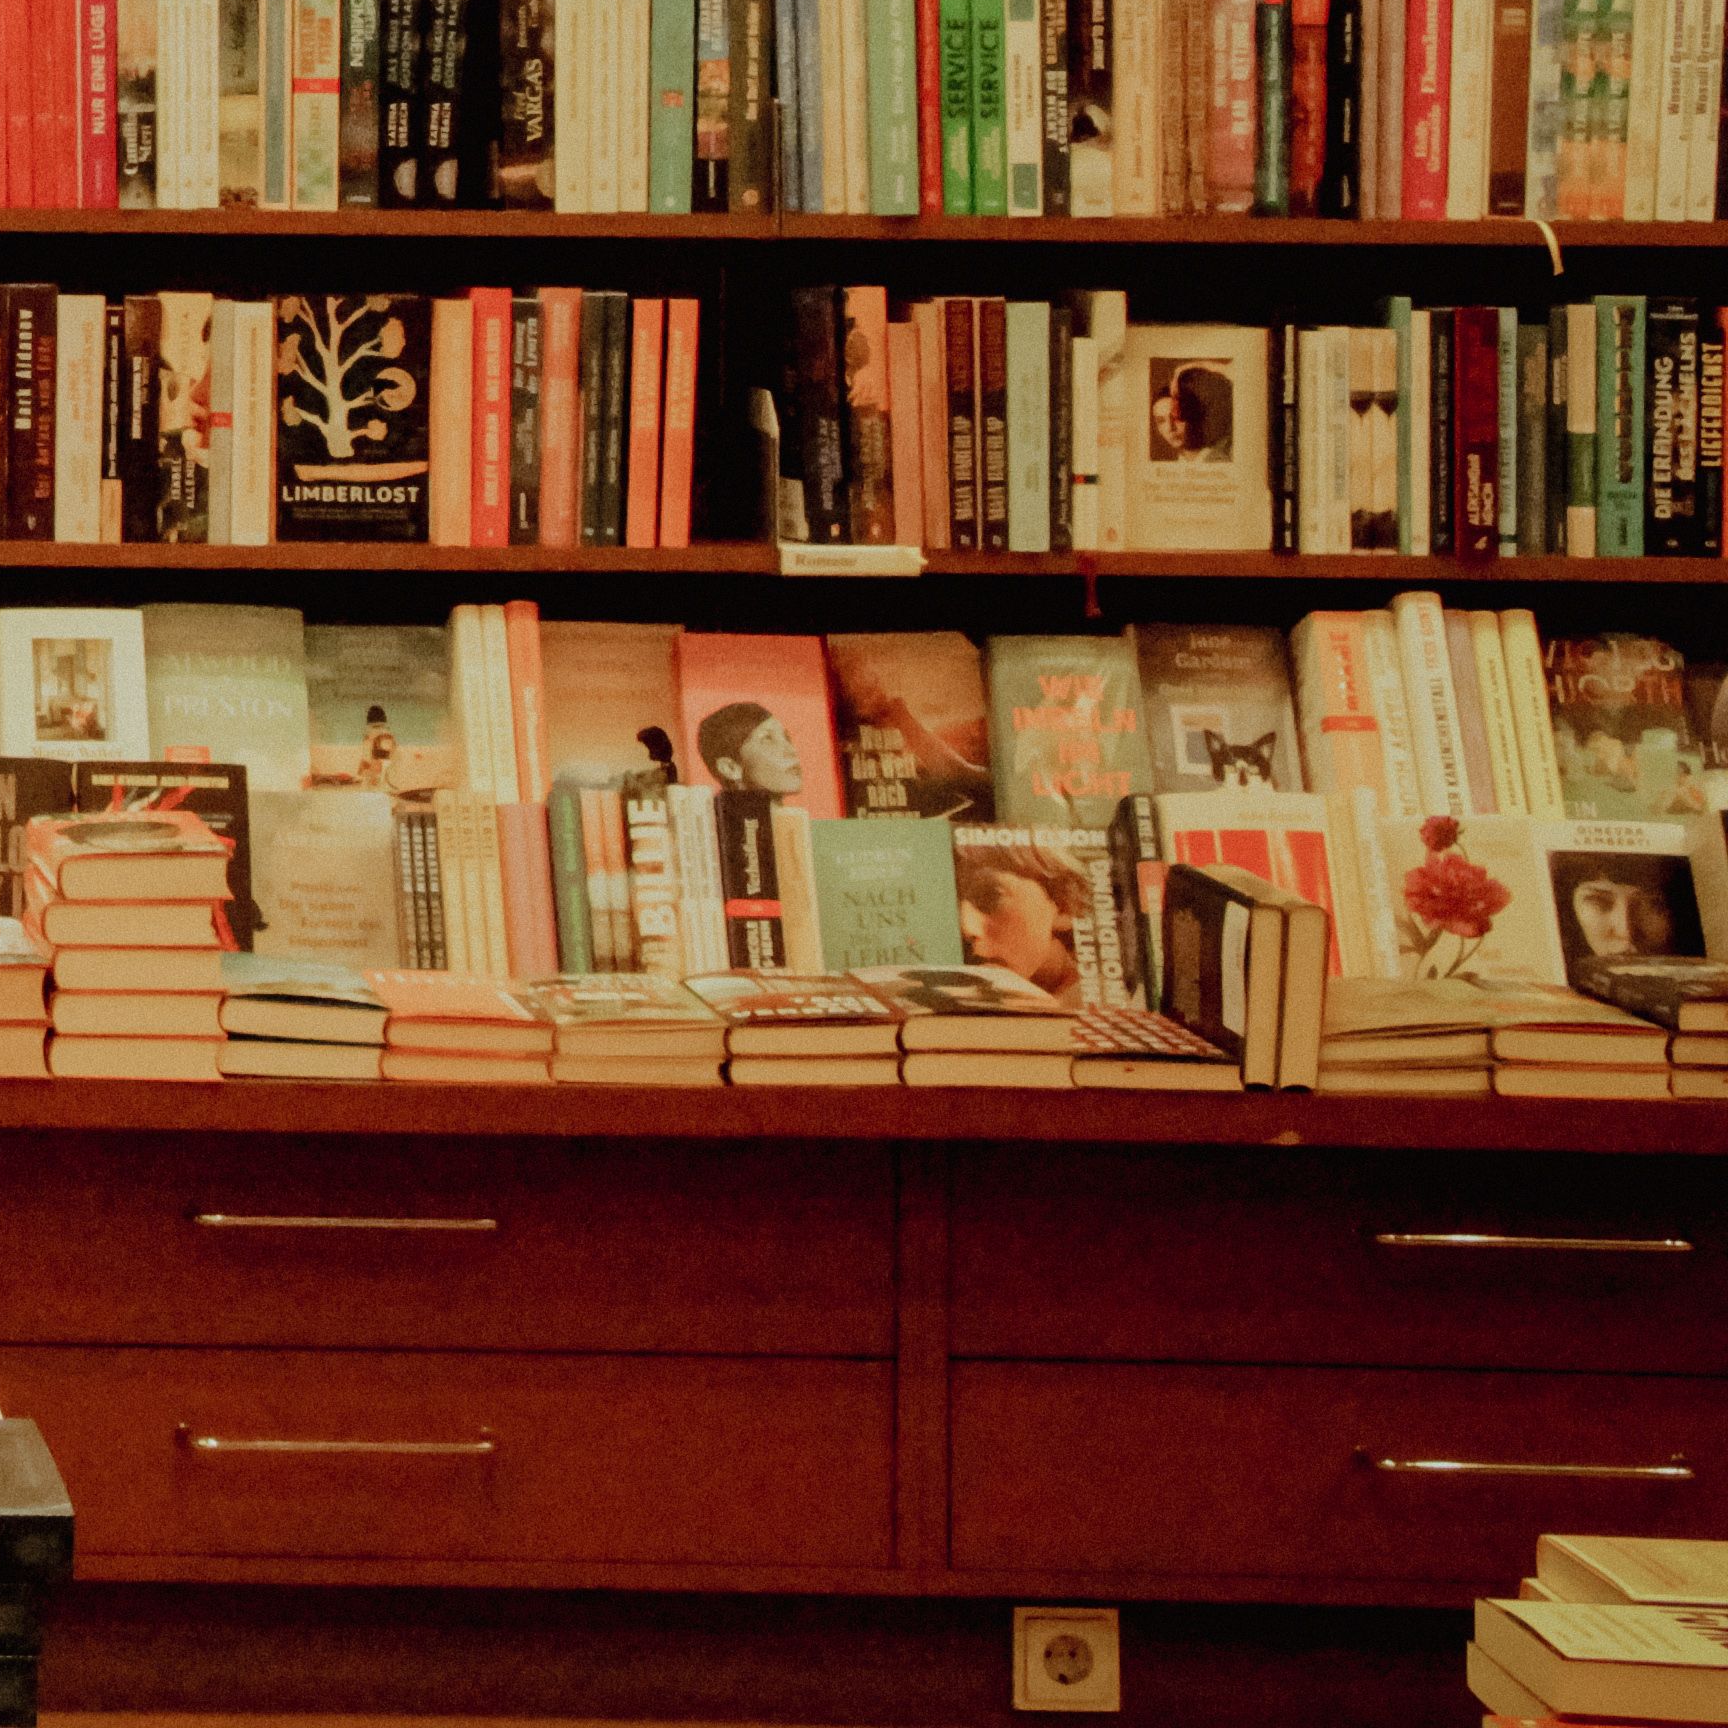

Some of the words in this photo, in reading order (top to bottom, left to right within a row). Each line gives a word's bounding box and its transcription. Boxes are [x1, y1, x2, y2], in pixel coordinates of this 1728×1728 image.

[88, 4, 106, 51] LÜGE
[90, 55, 106, 92] EINE
[945, 18, 967, 120] SERVICE
[978, 18, 1000, 120] SERVICE
[90, 97, 106, 136] NUR
[524, 58, 544, 143] VARGAS
[1654, 356, 1674, 483] ERFINDUNG
[1701, 341, 1724, 468] LIEFERDIENST
[281, 485, 419, 504] LIMBERLOST
[1654, 488, 1674, 520] DIE
[1029, 771, 1132, 799] LICHT
[953, 826, 1030, 847] SIMON
[841, 890, 917, 908] NACH
[856, 912, 908, 928] UNS
